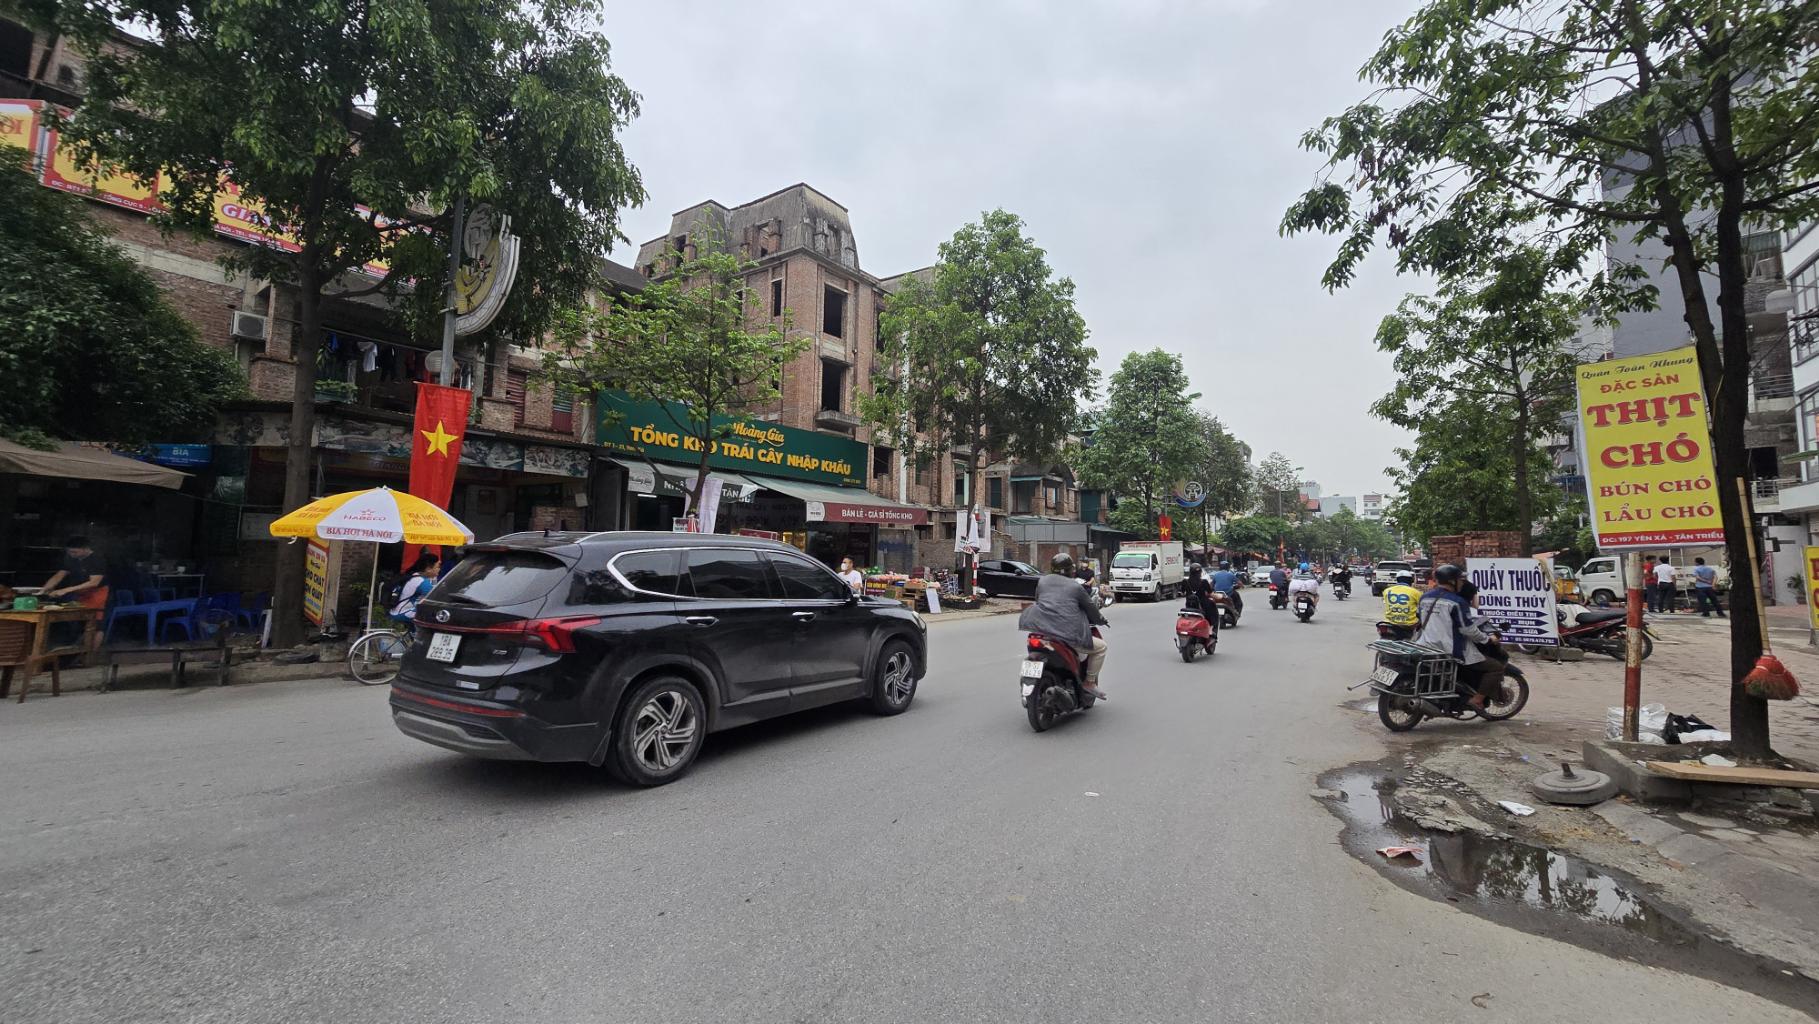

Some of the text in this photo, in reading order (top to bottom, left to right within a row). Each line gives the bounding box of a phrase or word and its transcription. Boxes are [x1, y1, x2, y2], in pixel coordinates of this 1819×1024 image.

[1600, 373, 1680, 393] ĐẶC SẢN
[1587, 392, 1702, 427] THỊT
[767, 427, 785, 443] Gia
[630, 423, 679, 447] TỔNG
[721, 441, 753, 460] TRÁI
[757, 449, 784, 464] CÂY
[786, 454, 819, 472] NHẬP
[1600, 432, 1700, 469] CHÓ
[1600, 475, 1712, 497] BÚN CHÓ
[842, 509, 856, 517] BÁN
[868, 510, 879, 519] GIÁ
[884, 511, 900, 519] TỔNG
[1603, 501, 1714, 522] LẨU CHÓ
[326, 527, 341, 535] BIA
[1388, 590, 1410, 605] be
[1478, 594, 1511, 607] DŨNG
